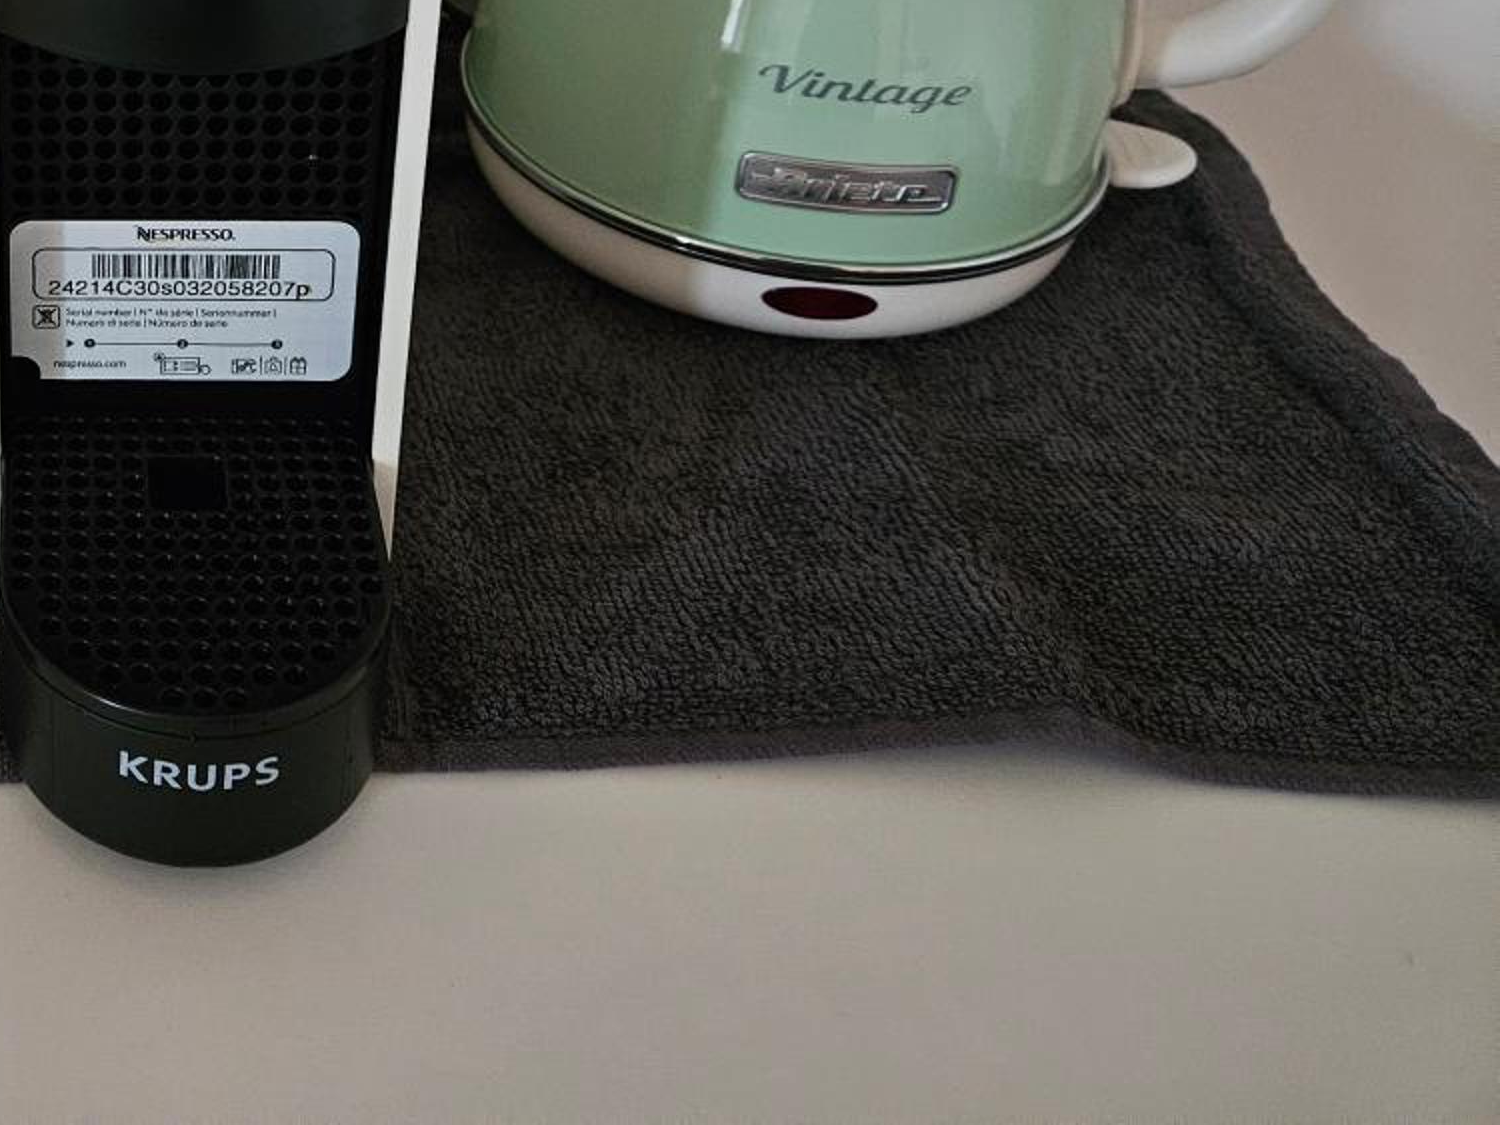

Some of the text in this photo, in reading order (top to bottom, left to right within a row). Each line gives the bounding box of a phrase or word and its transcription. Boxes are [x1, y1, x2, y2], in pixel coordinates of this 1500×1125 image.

[758, 63, 973, 114] Vintage
[48, 279, 312, 300] 24214C30s032058207p
[66, 307, 93, 318] Serial
[94, 307, 131, 318] number
[53, 358, 128, 370] nespresso.com
[119, 750, 280, 792] KRUPS
